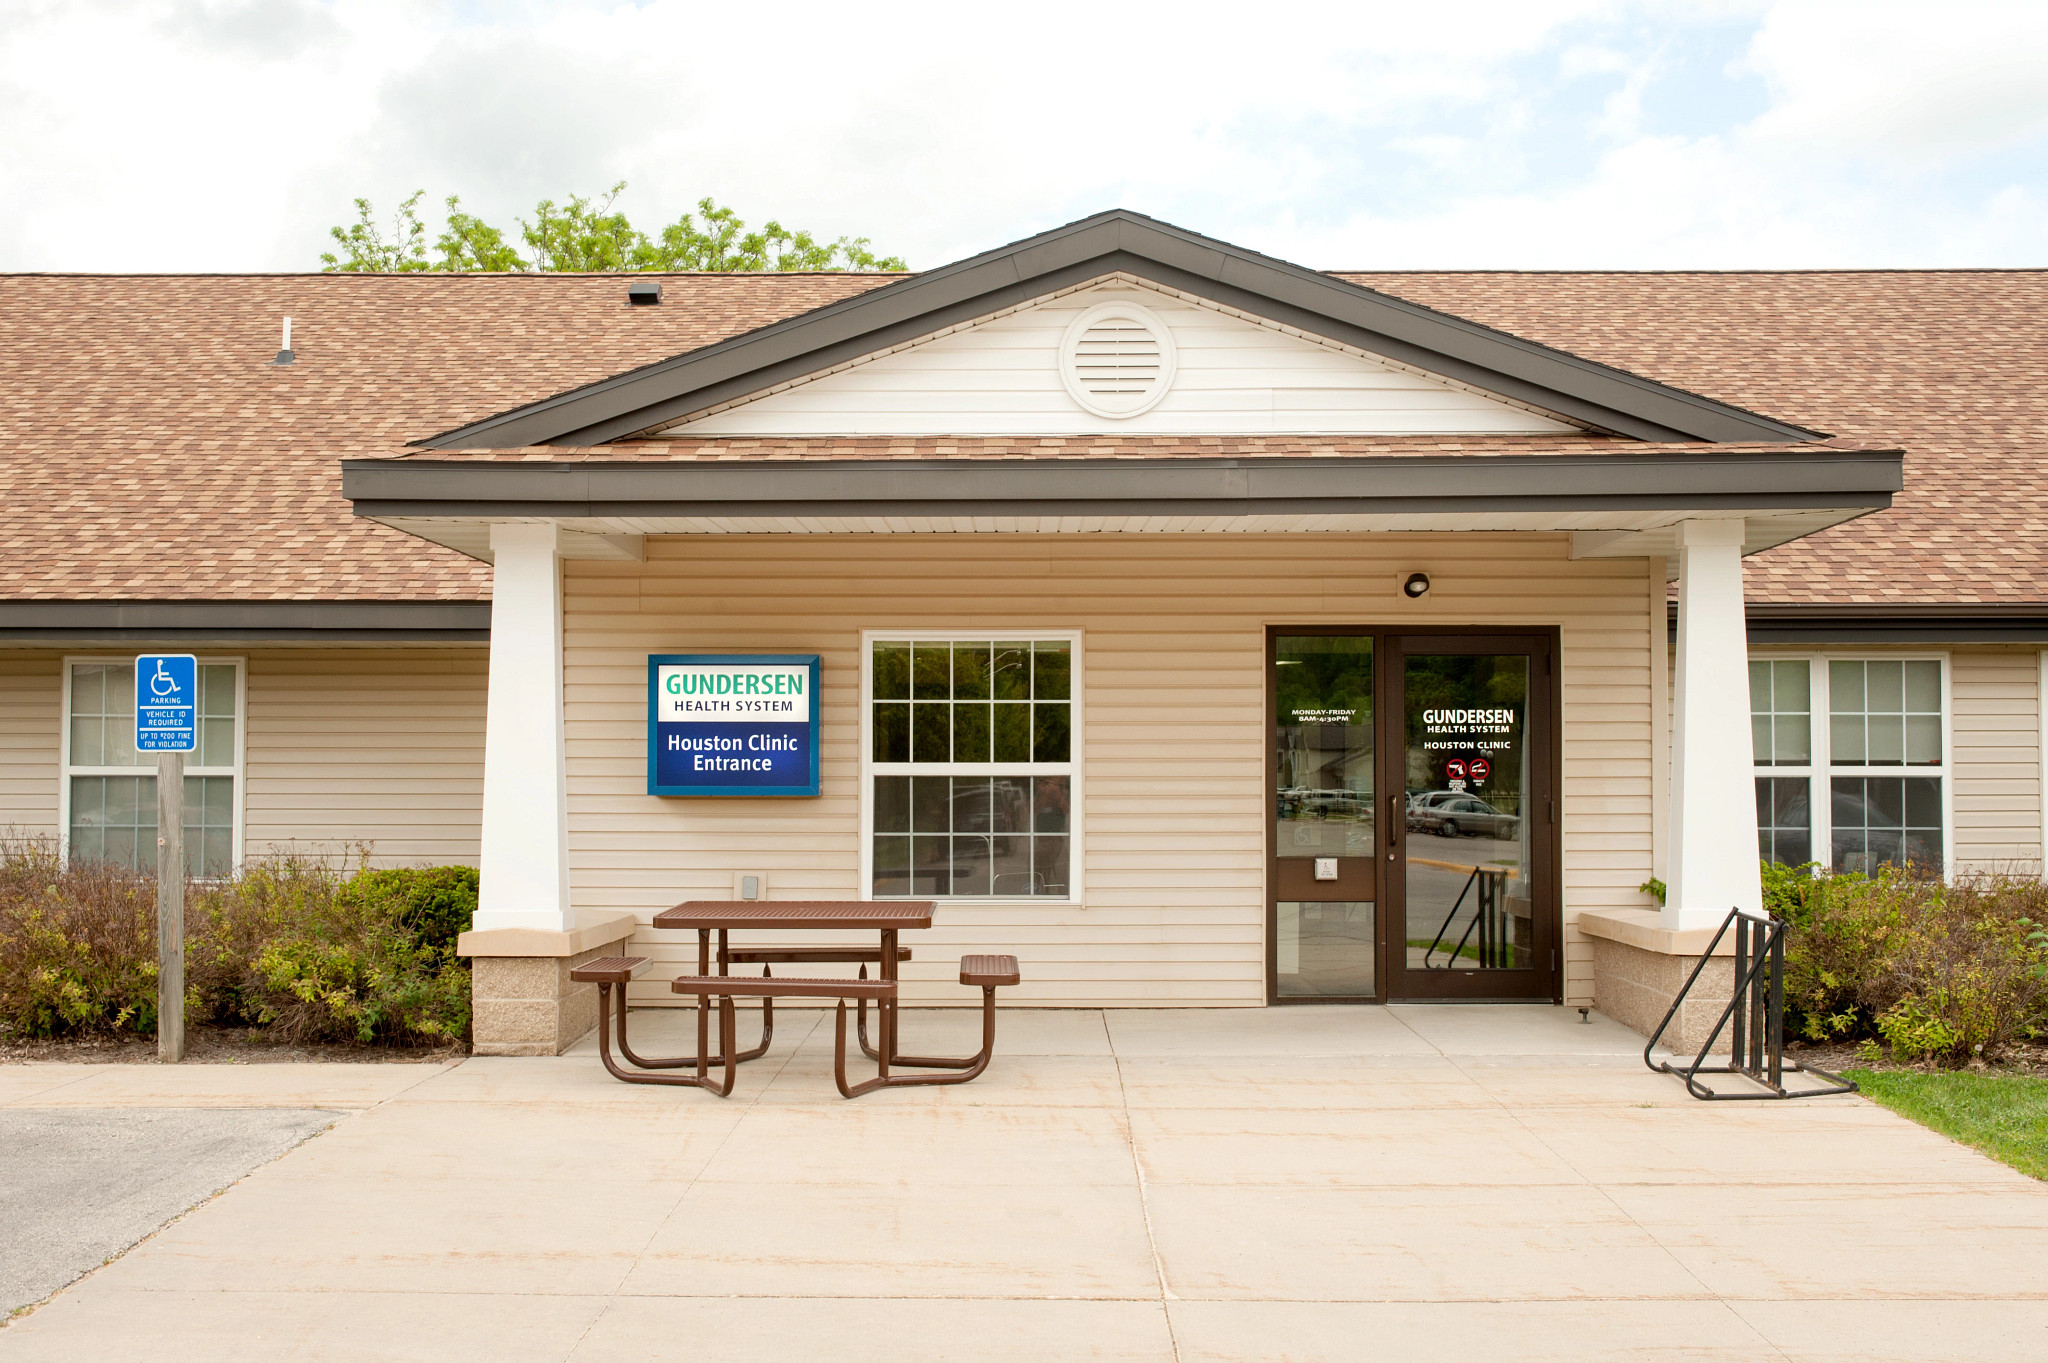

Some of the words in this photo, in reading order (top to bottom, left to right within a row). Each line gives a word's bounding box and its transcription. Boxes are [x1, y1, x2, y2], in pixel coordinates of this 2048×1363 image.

[666, 674, 803, 695] GUNDERSEN
[674, 700, 730, 712] HEALTH
[735, 700, 793, 712] SYSTEM
[1422, 709, 1514, 724] GUNDERSEN
[1427, 725, 1467, 733] HEALTH
[1469, 725, 1510, 733] SYSTEM
[160, 732, 175, 740] $200
[668, 734, 743, 751] Houston
[748, 734, 798, 751] Clinic
[1424, 741, 1474, 750] HOUSTON
[1477, 741, 1511, 749] CLINIC
[693, 754, 772, 771] Entrance
